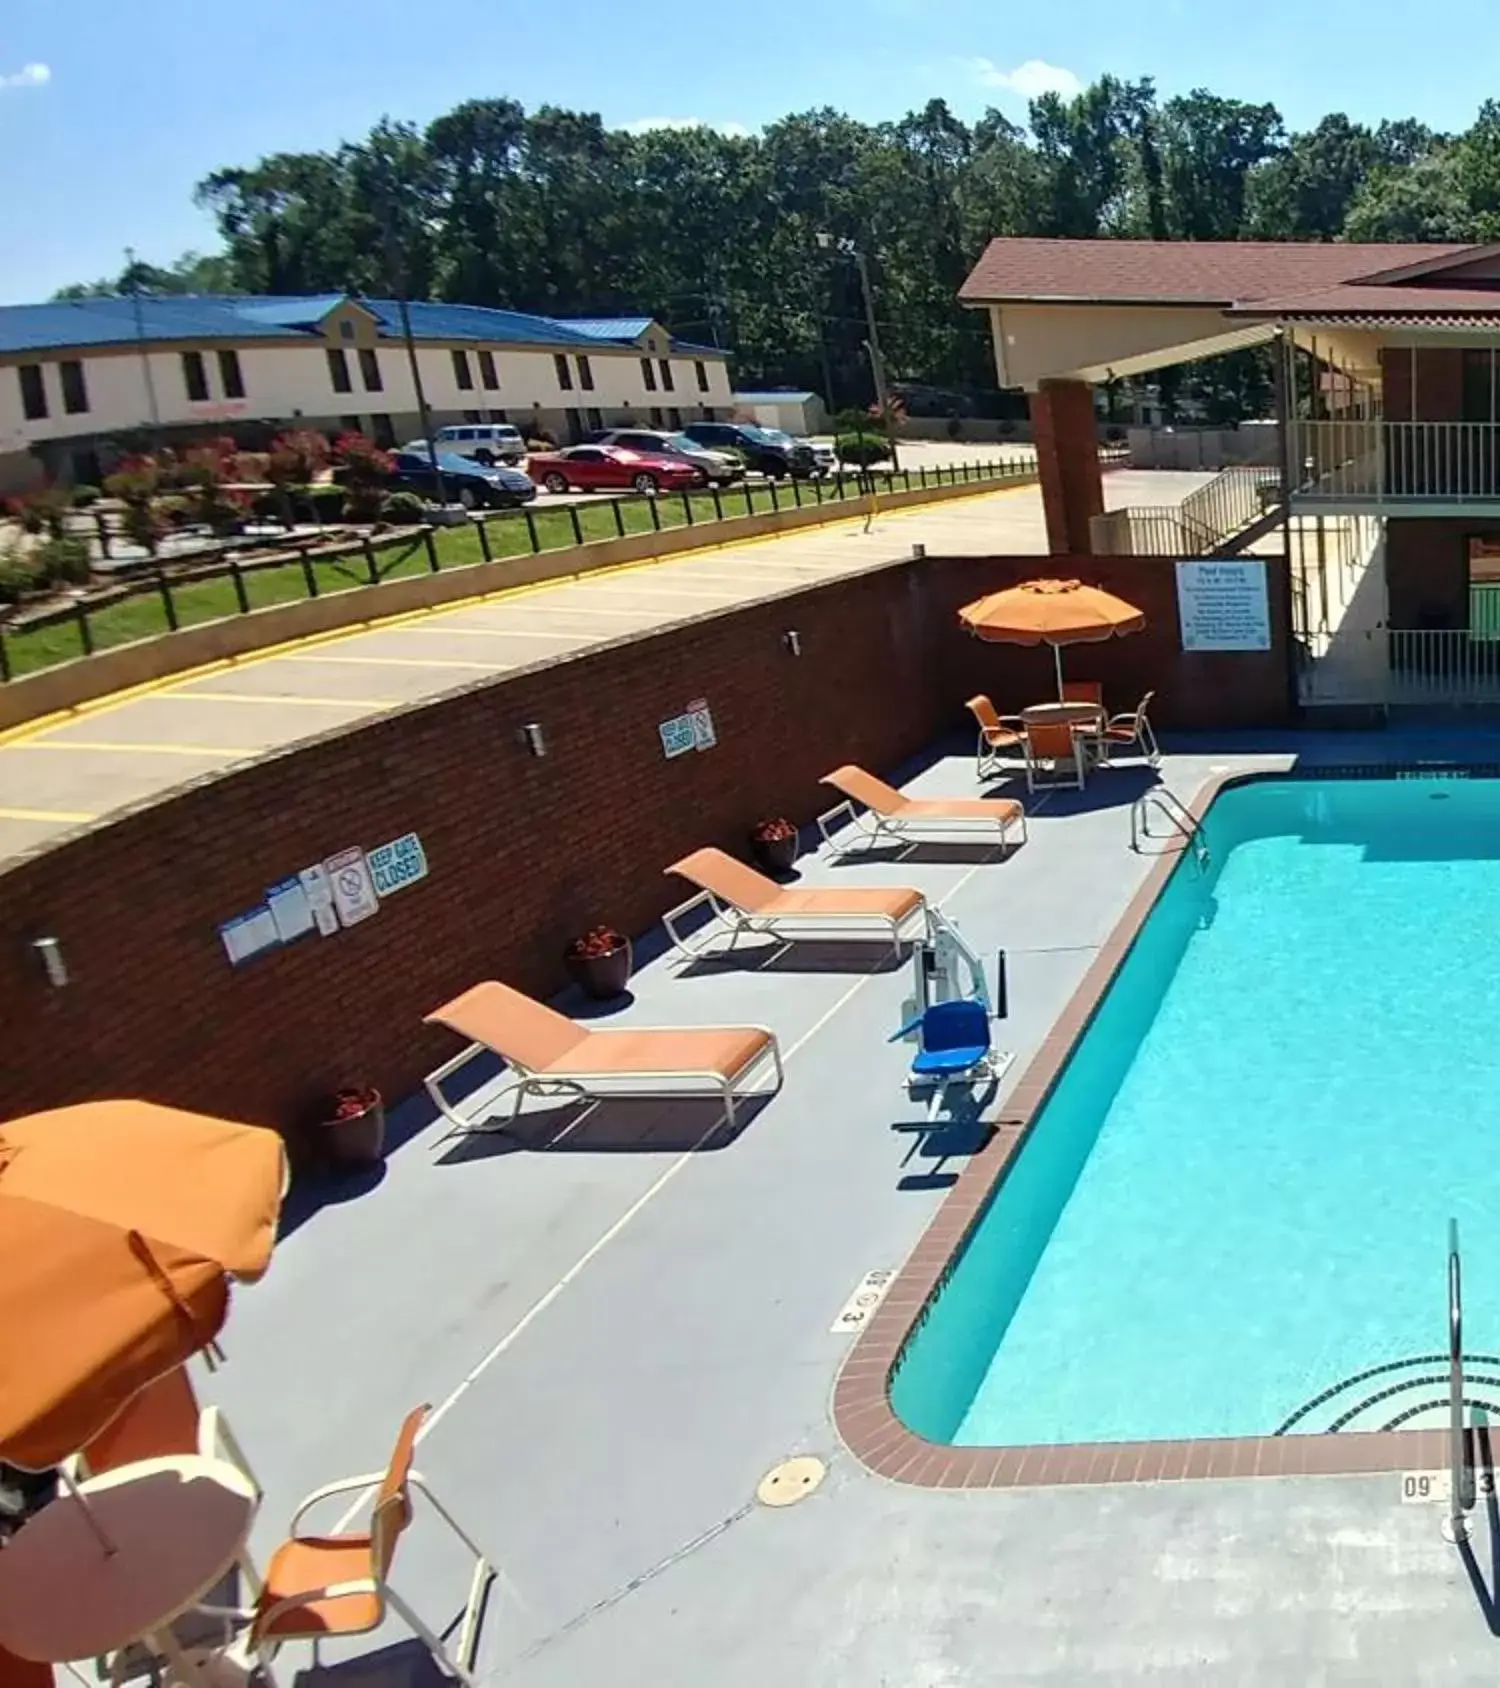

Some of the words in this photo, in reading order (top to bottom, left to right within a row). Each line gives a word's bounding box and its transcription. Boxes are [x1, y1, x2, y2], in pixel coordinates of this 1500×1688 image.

[370, 847, 393, 870] KEEP
[842, 1312, 865, 1323] 3
[1405, 1476, 1430, 1497] 09
[1479, 1472, 1494, 1493] 3
